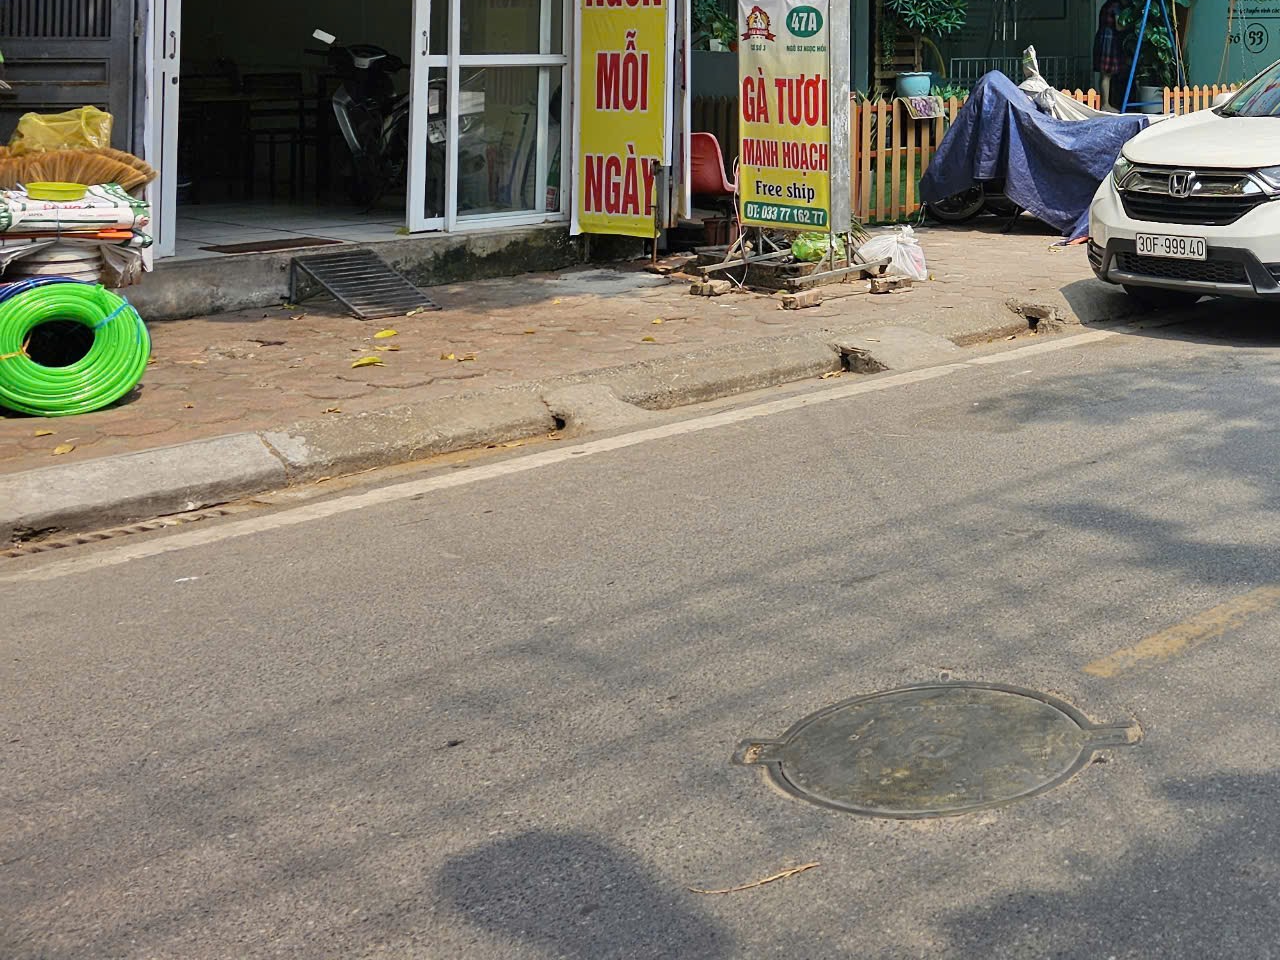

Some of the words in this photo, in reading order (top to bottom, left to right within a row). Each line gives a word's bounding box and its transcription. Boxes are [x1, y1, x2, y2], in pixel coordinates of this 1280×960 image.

[791, 12, 817, 31] 47A
[596, 31, 649, 111] MỖI
[743, 67, 769, 123] GÀ
[775, 74, 827, 126] TƯƠI
[743, 139, 778, 172] MẠNH
[782, 142, 827, 176] HOẠCH
[584, 142, 655, 216] NGÀY
[756, 180, 782, 197] Free
[787, 183, 814, 203] ship
[762, 205, 777, 220] 033
[780, 207, 790, 222] 77
[793, 208, 810, 223] 162
[813, 210, 823, 225] 77
[1138, 236, 1204, 256] 30F-999.40
